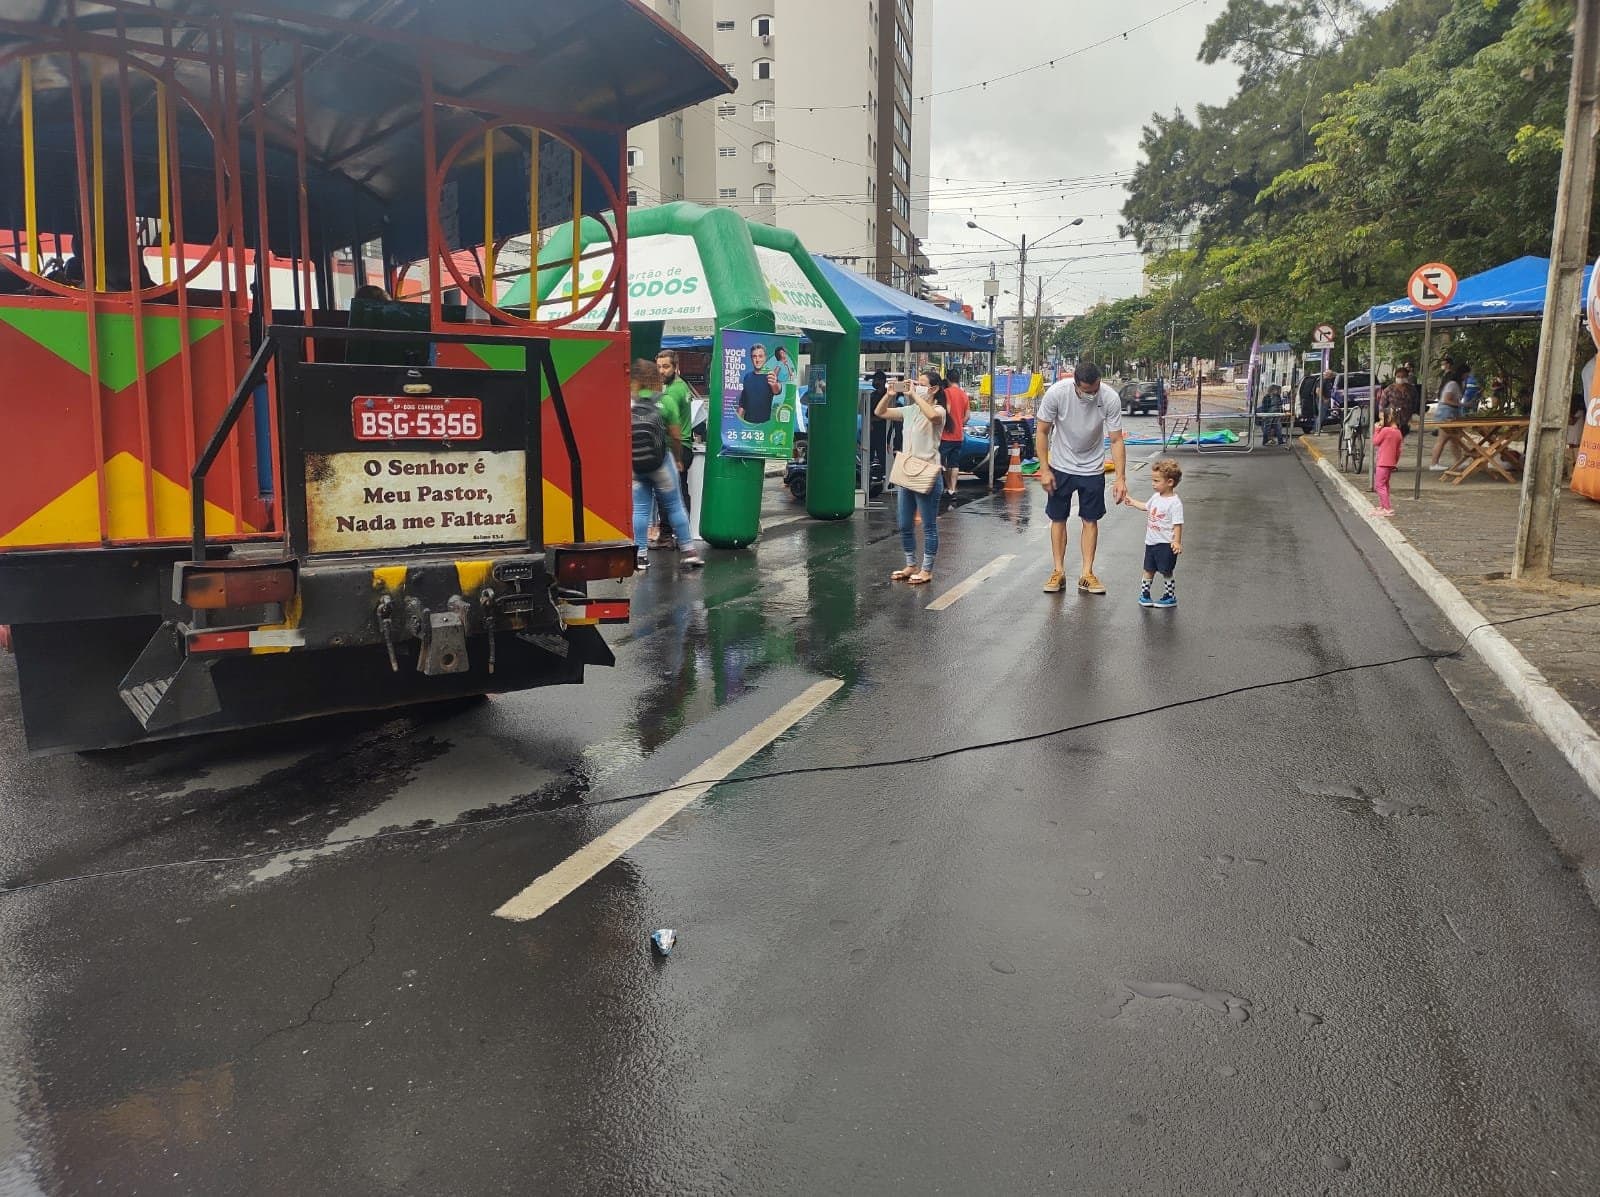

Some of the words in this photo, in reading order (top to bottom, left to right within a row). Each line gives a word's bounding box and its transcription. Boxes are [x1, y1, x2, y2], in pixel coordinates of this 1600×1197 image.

[628, 269, 662, 280] artão
[667, 266, 682, 277] de
[628, 276, 698, 298] ODOS
[1422, 273, 1441, 300] E
[874, 324, 897, 335] Sesc
[725, 348, 746, 357] VOCÊ
[724, 383, 744, 391] MAIS
[727, 430, 738, 439] 25
[741, 431, 752, 440] 24
[754, 432, 765, 441] 32
[364, 459, 382, 476] O
[388, 458, 467, 476] Senhor
[474, 458, 485, 475] é
[363, 487, 411, 504] Meu
[417, 485, 493, 504] Pastor,
[336, 515, 396, 532] Nada
[402, 515, 434, 530] me
[440, 508, 517, 529] Faltará
